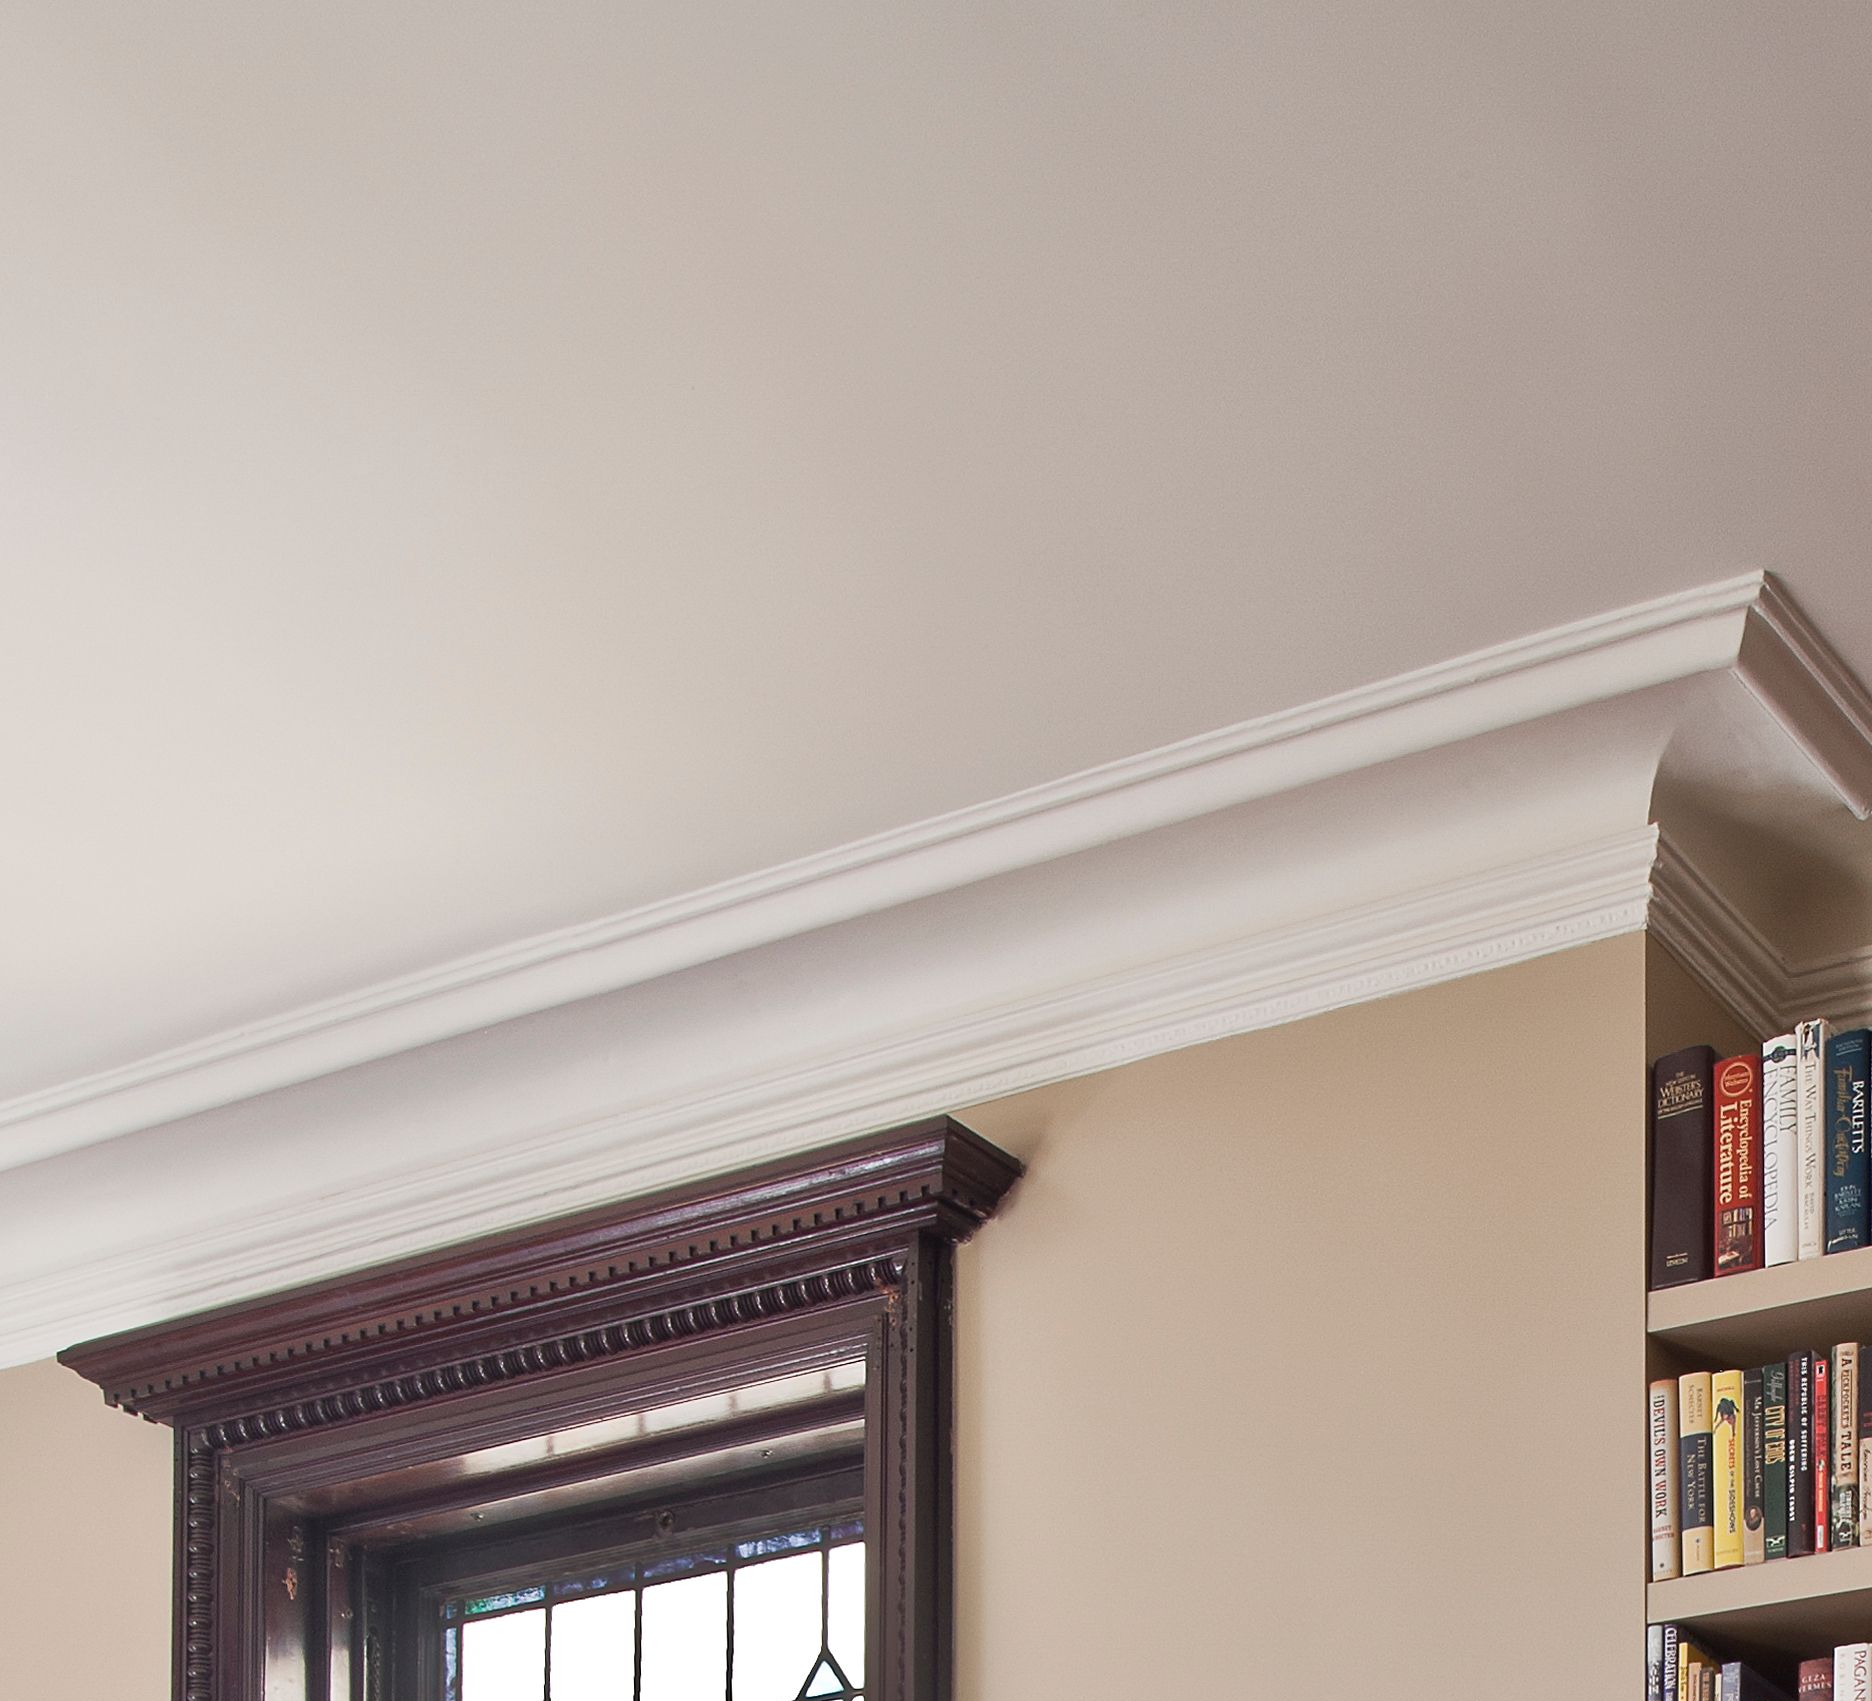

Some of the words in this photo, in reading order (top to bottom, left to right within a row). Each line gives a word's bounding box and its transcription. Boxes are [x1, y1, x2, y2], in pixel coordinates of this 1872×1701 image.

[1718, 1104, 1736, 1204] Literature
[1737, 1100, 1750, 1181] Encyclopedia
[1738, 1185, 1750, 1199] of
